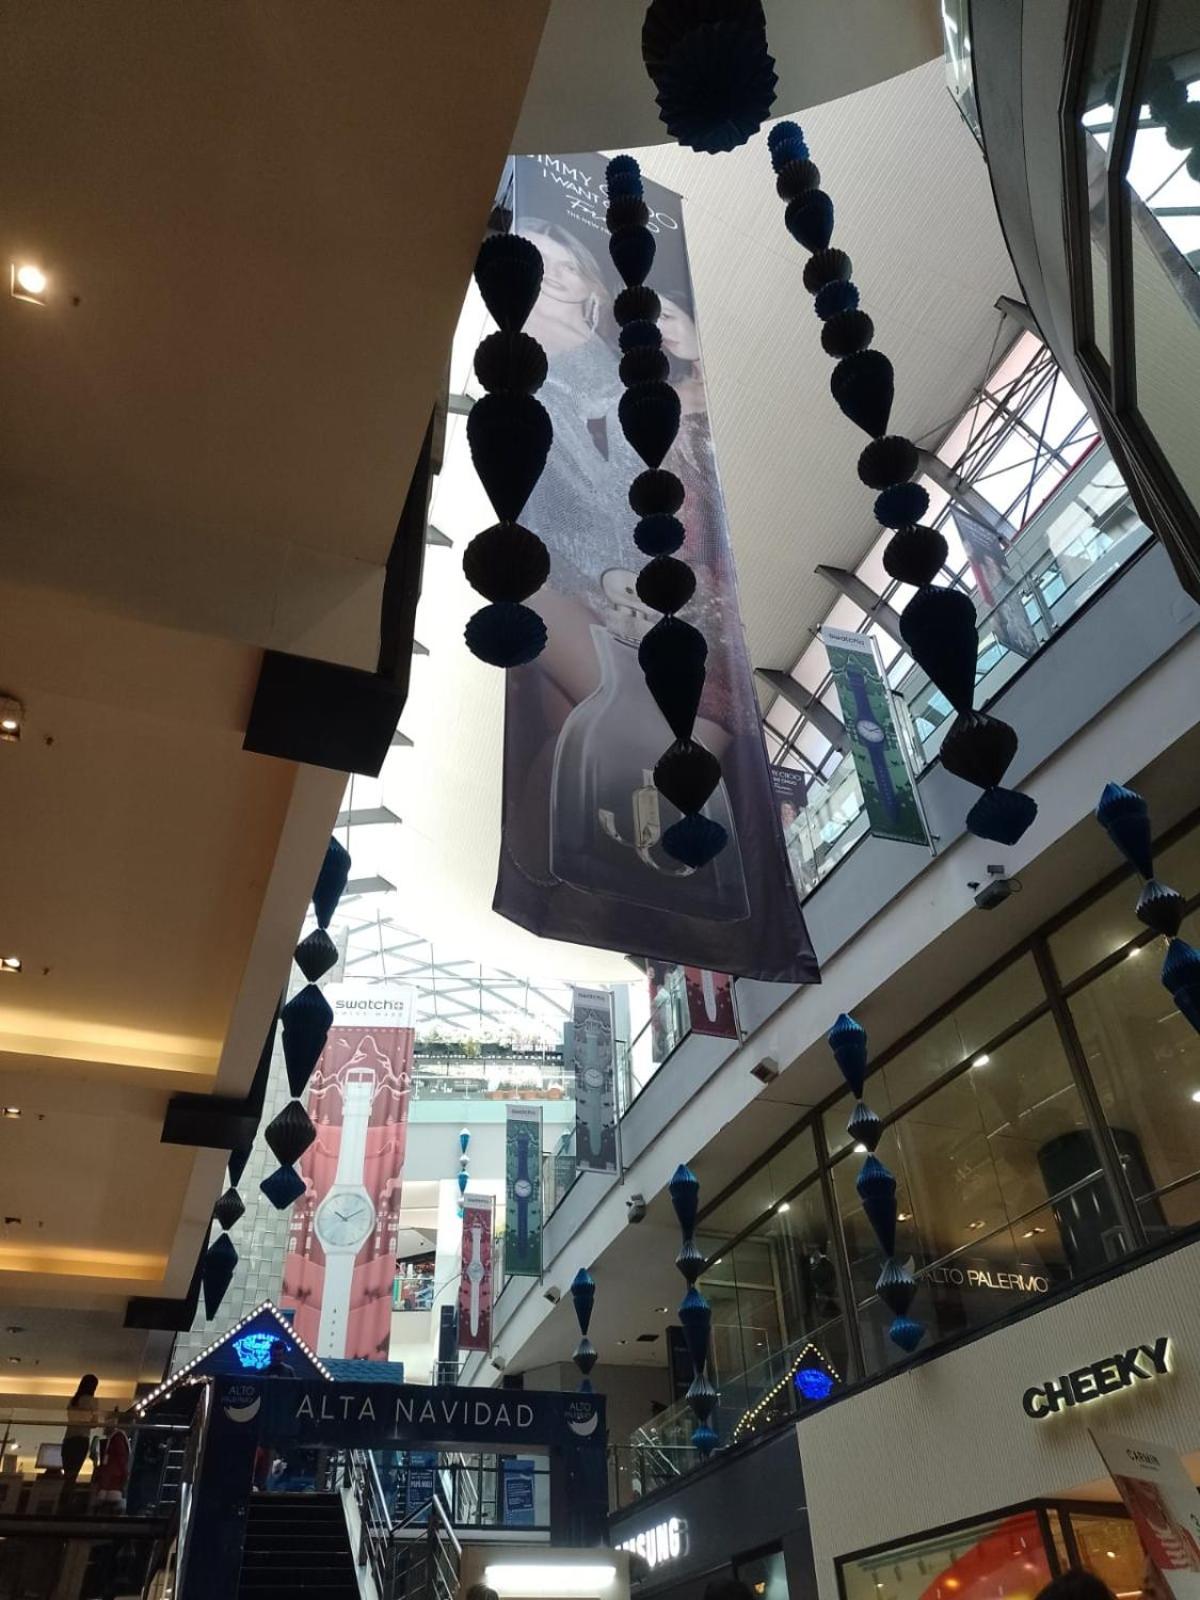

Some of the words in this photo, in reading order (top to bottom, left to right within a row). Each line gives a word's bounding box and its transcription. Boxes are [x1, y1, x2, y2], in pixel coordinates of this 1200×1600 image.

[527, 154, 592, 186] IMMY
[550, 171, 600, 203] WANT
[335, 999, 393, 1010] swatch
[967, 1269, 1049, 1293] PALERMO
[1022, 1337, 1172, 1419] CHEEKY
[296, 1394, 376, 1421] ALTA
[396, 1398, 535, 1427] NAVIDAD
